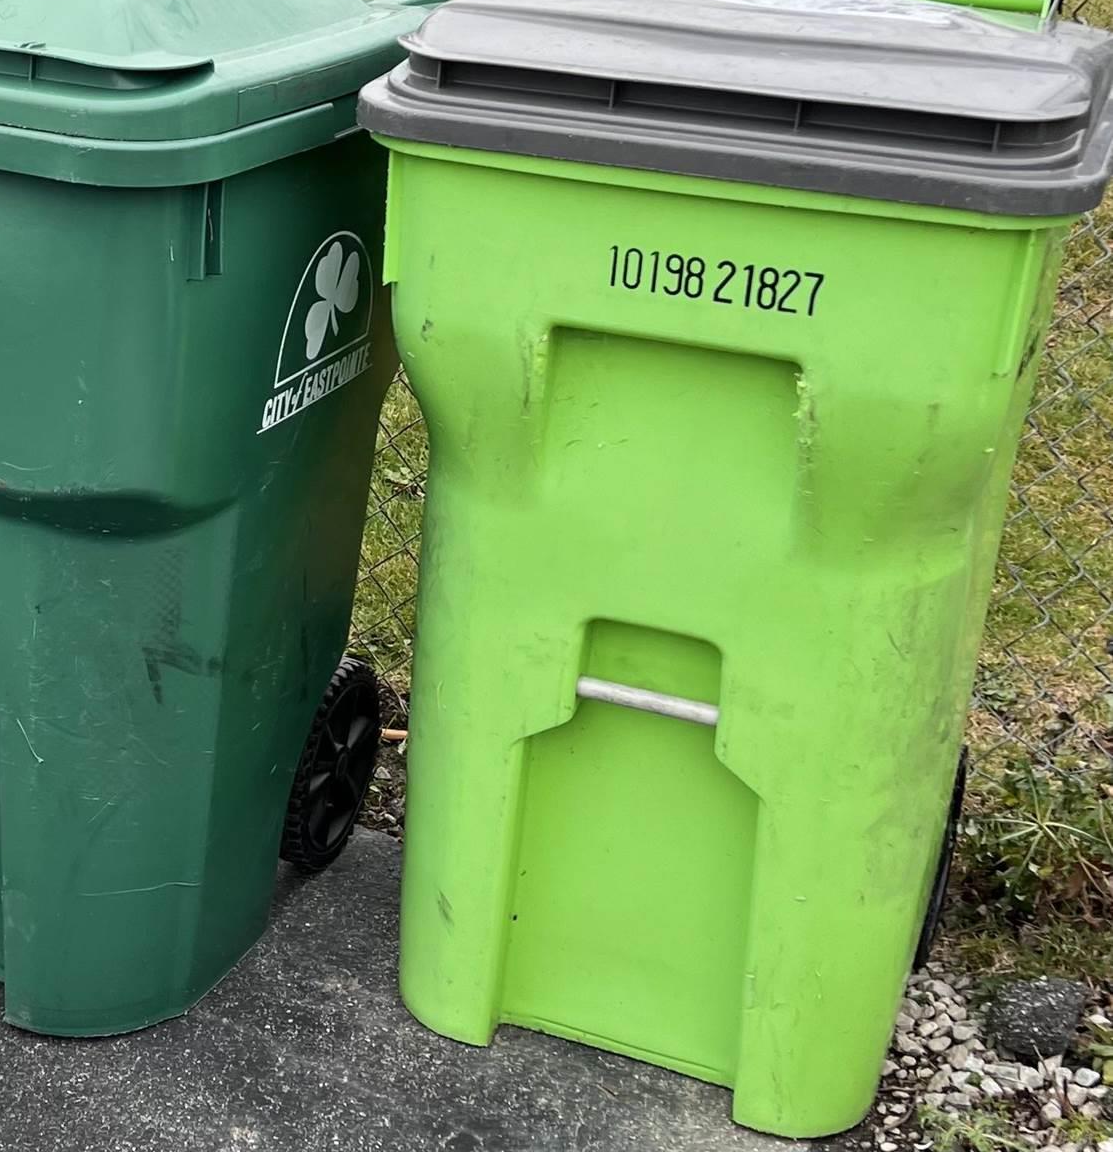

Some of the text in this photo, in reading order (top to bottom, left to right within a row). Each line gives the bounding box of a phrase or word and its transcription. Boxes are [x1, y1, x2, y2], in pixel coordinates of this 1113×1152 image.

[610, 245, 825, 316] 10198 21827
[262, 388, 293, 428] CITY
[303, 343, 372, 406] EASTPOINTE
